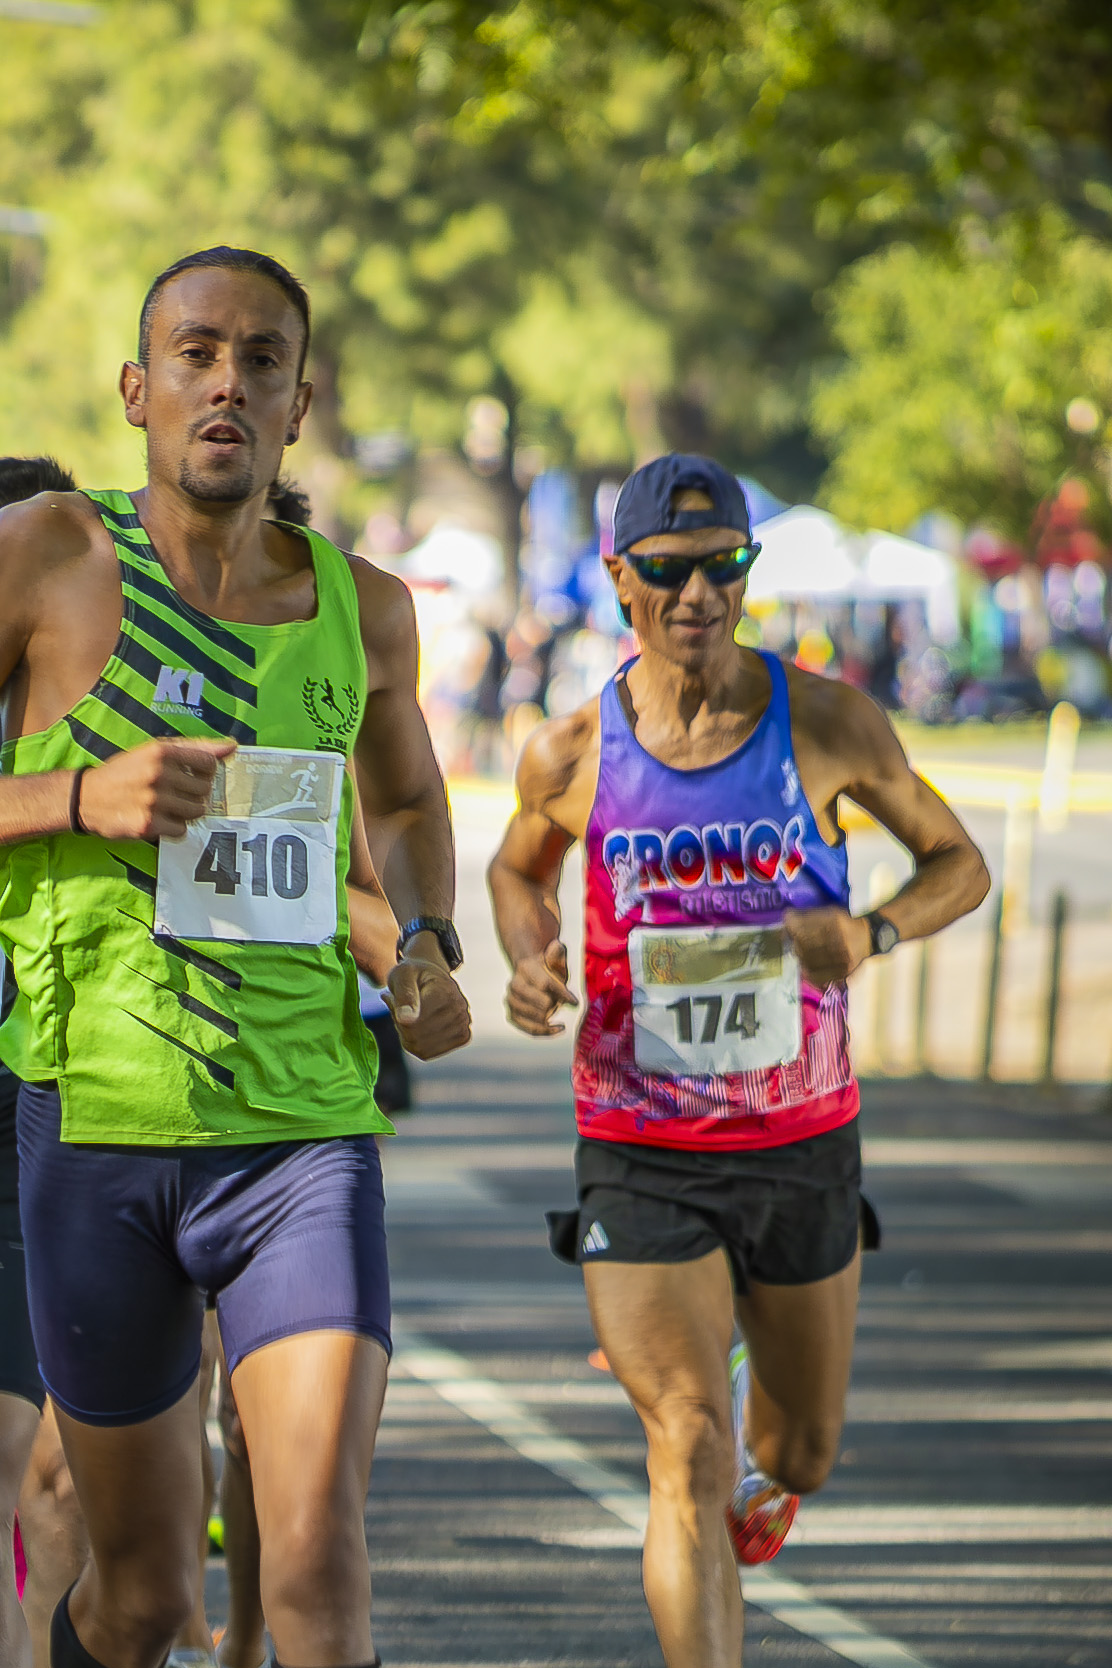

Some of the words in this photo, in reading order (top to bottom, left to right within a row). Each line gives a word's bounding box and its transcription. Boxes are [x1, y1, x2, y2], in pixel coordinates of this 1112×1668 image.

[150, 701, 204, 718] RUNNING
[194, 832, 308, 900] 410
[665, 992, 760, 1044] 174
